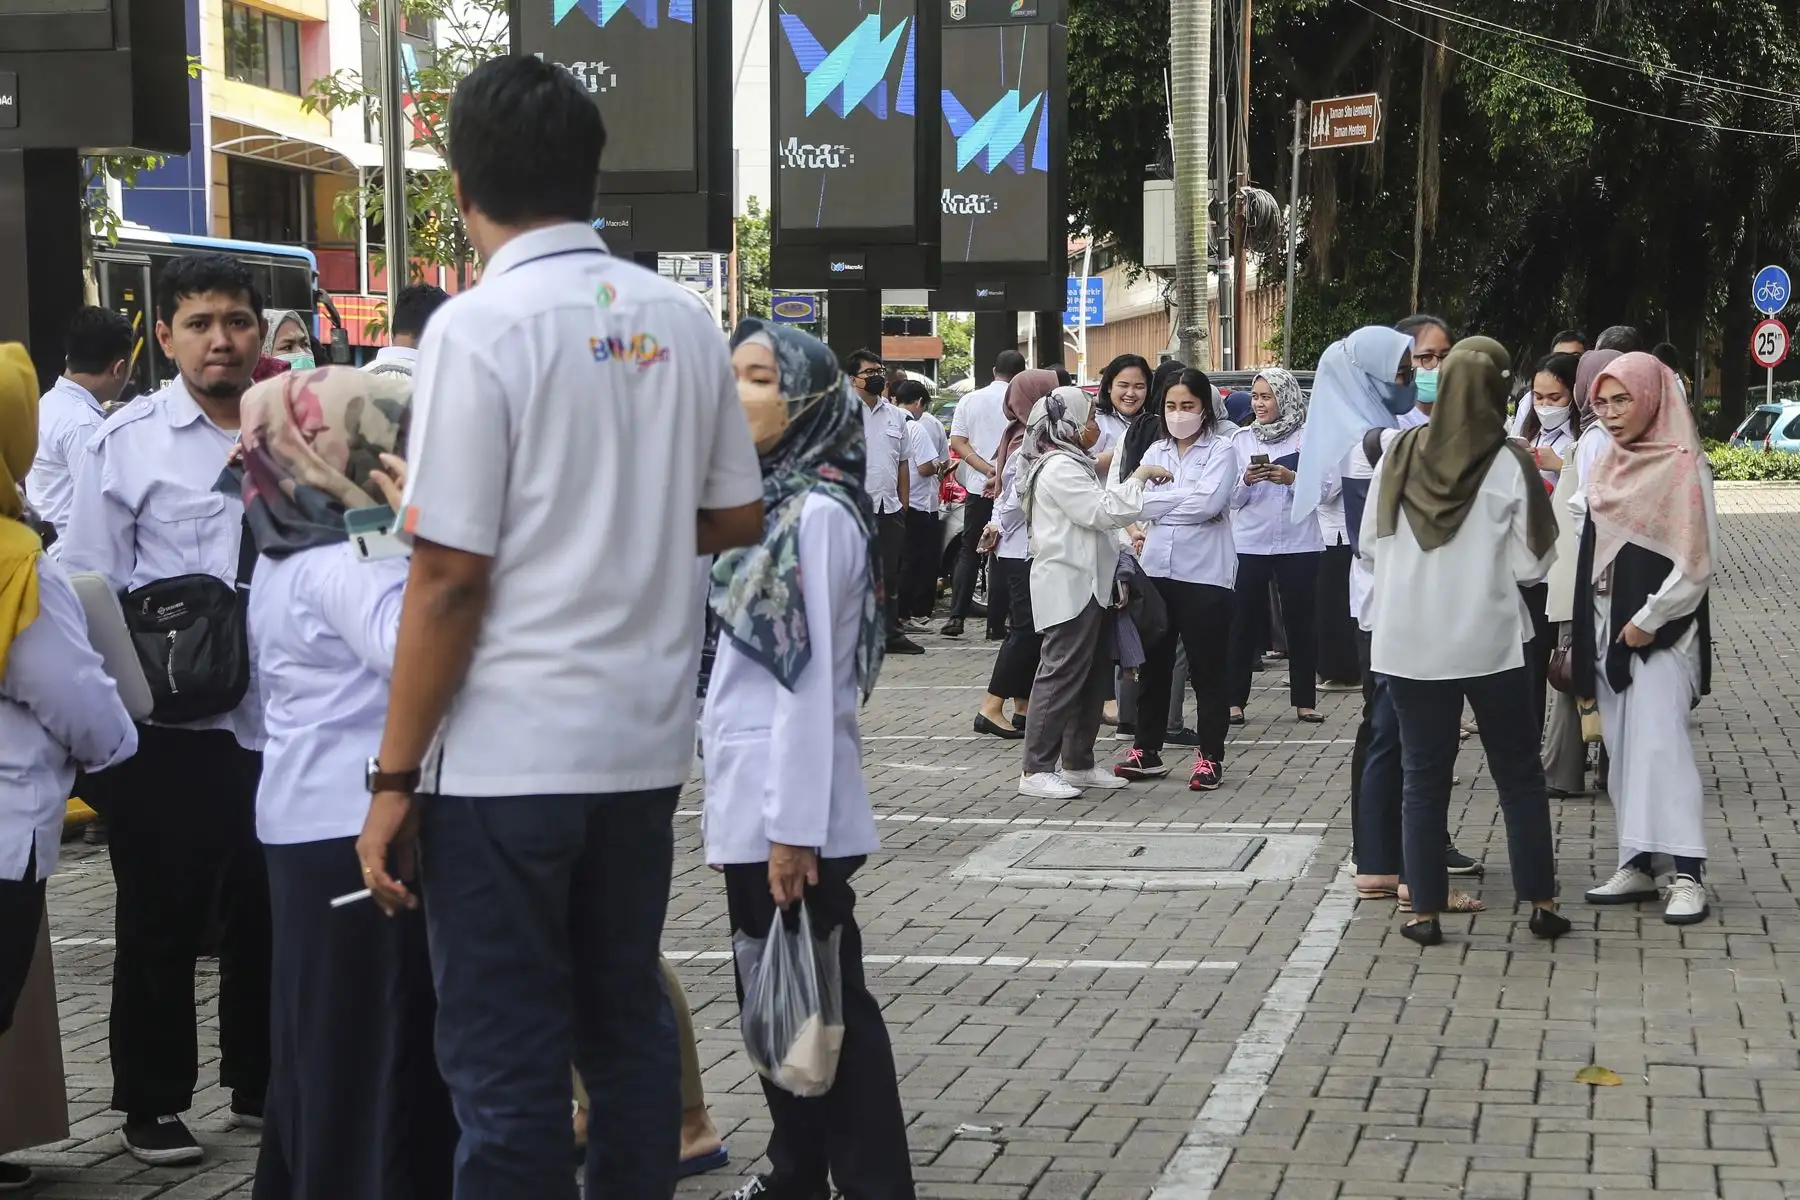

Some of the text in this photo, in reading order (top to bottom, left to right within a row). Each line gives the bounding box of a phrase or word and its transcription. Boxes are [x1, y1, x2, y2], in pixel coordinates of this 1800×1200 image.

[1330, 104, 1373, 119] Taman Situ Lembang
[1333, 124, 1367, 138] Taman Menteng
[1758, 332, 1775, 355] 25
